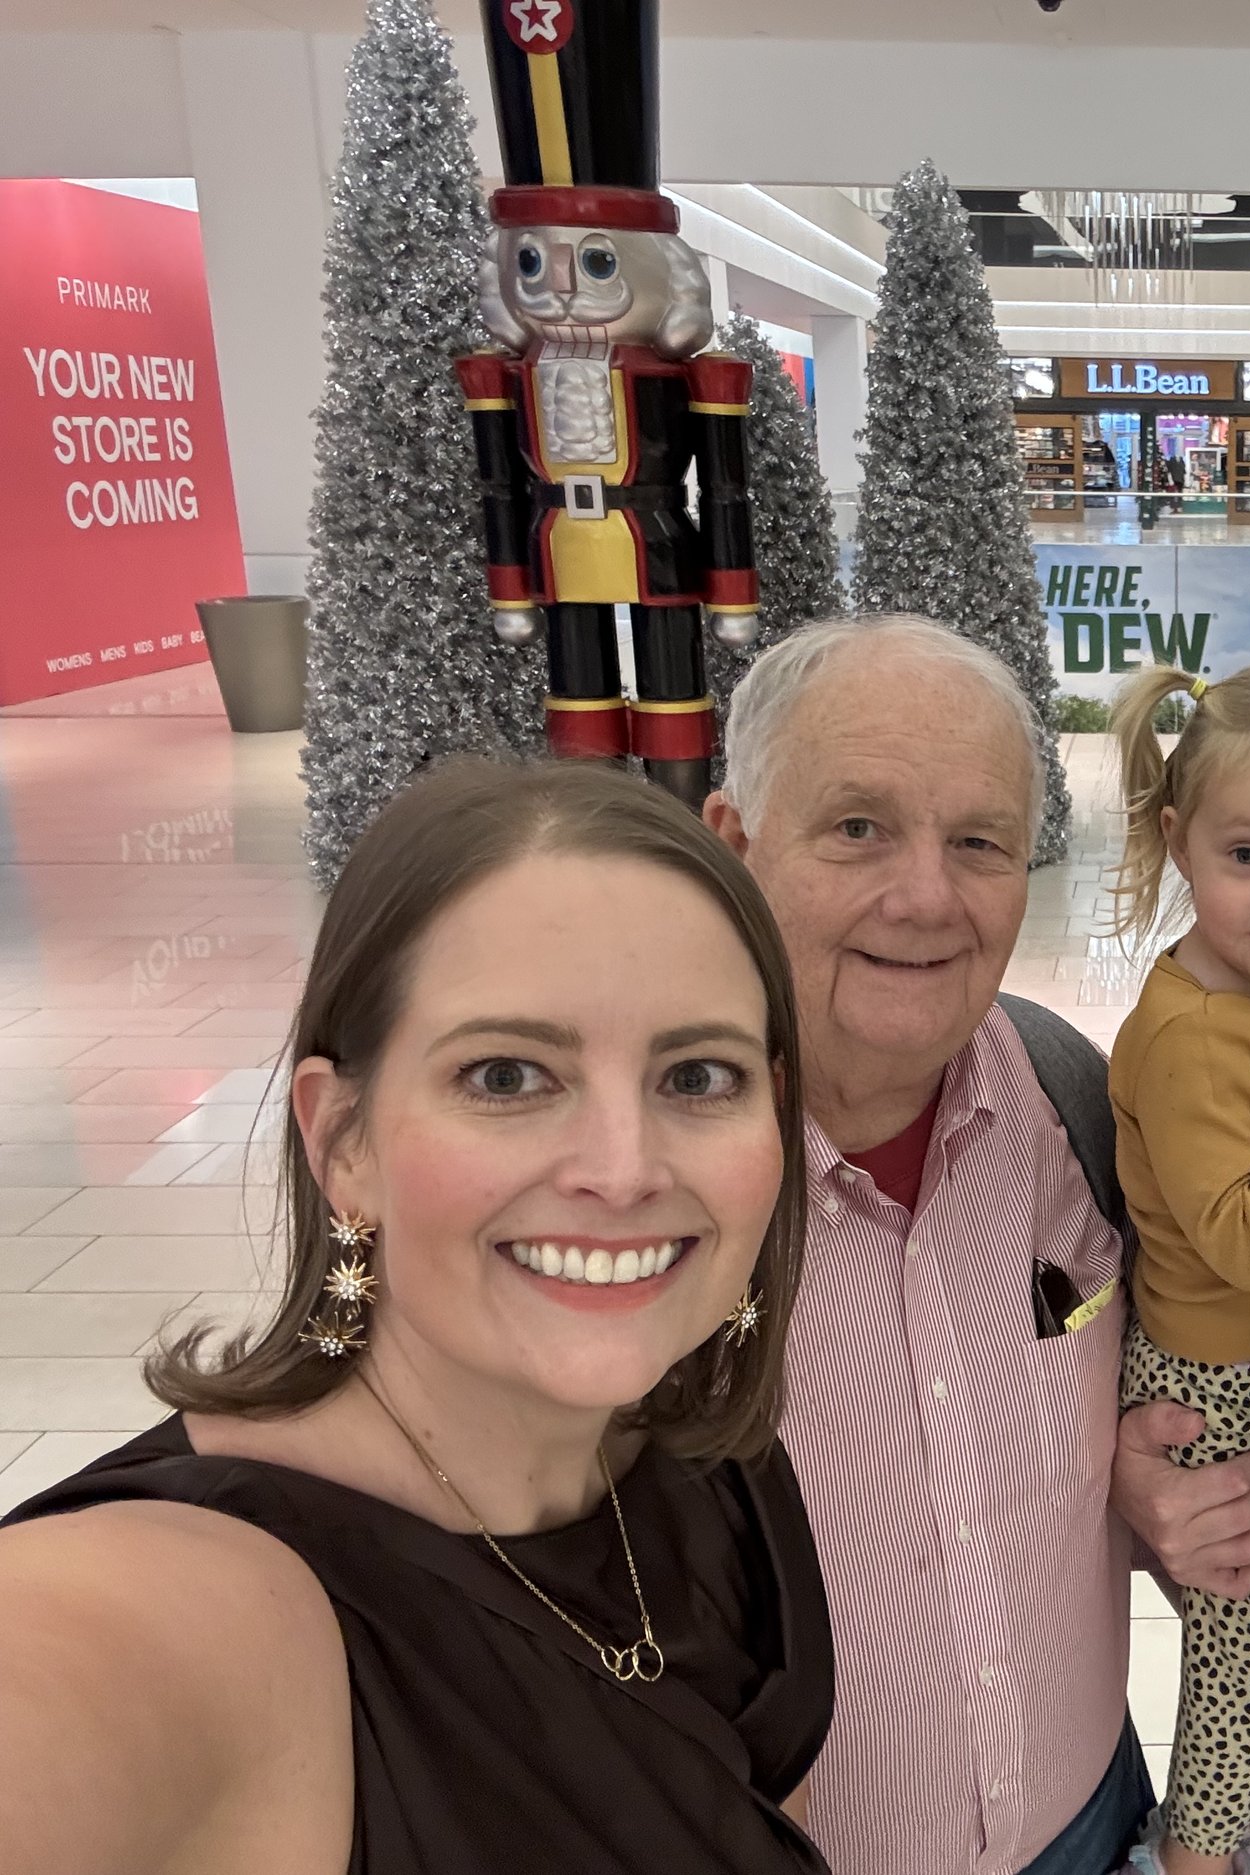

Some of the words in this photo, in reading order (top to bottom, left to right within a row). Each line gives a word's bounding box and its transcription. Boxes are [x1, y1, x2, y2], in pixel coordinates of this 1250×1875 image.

[57, 276, 152, 314] PRIMARK
[23, 347, 124, 399] YOUR
[128, 354, 195, 402] NEW
[1086, 363, 1210, 395] L.L.Bean
[52, 415, 162, 465] STORE
[164, 417, 194, 462] IS
[66, 476, 199, 530] COMING
[1046, 565, 1150, 612] HERE,
[46, 652, 93, 673] WOMENS
[100, 645, 127, 663] MENS
[133, 640, 155, 655] KIDS
[160, 634, 183, 650] BABY
